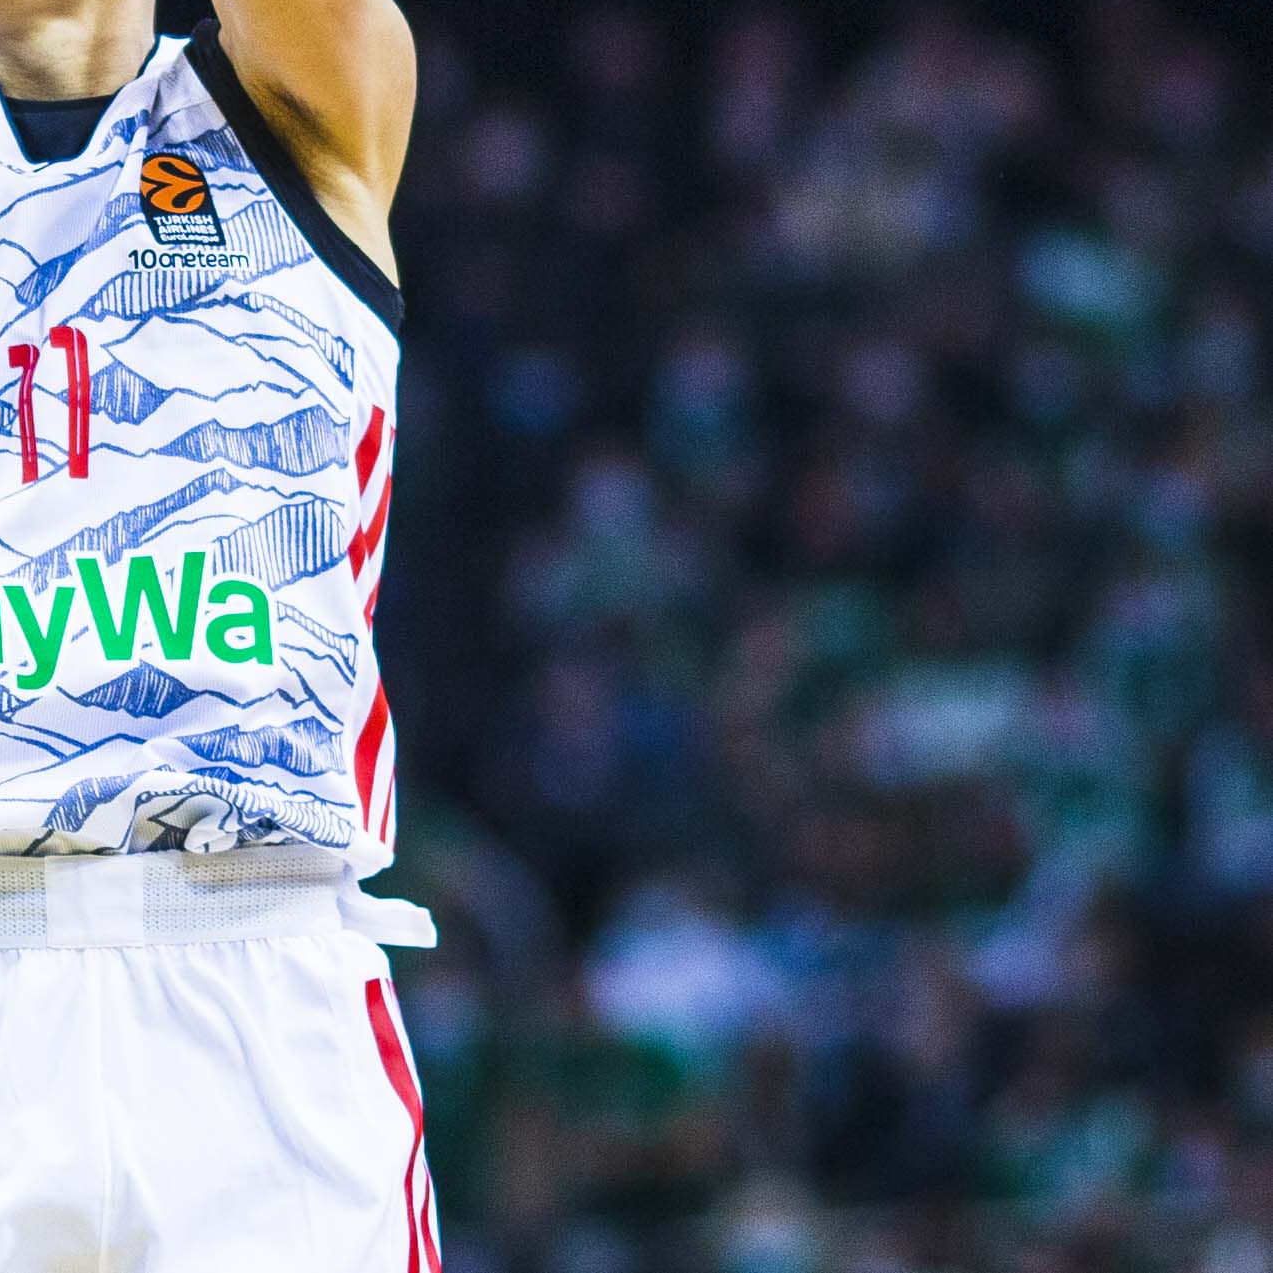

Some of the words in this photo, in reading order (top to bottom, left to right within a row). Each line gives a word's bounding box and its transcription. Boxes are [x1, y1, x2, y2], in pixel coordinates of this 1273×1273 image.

[153, 215, 214, 226] TURKISH
[158, 224, 218, 235] AIRLINES
[8, 325, 89, 485] 11
